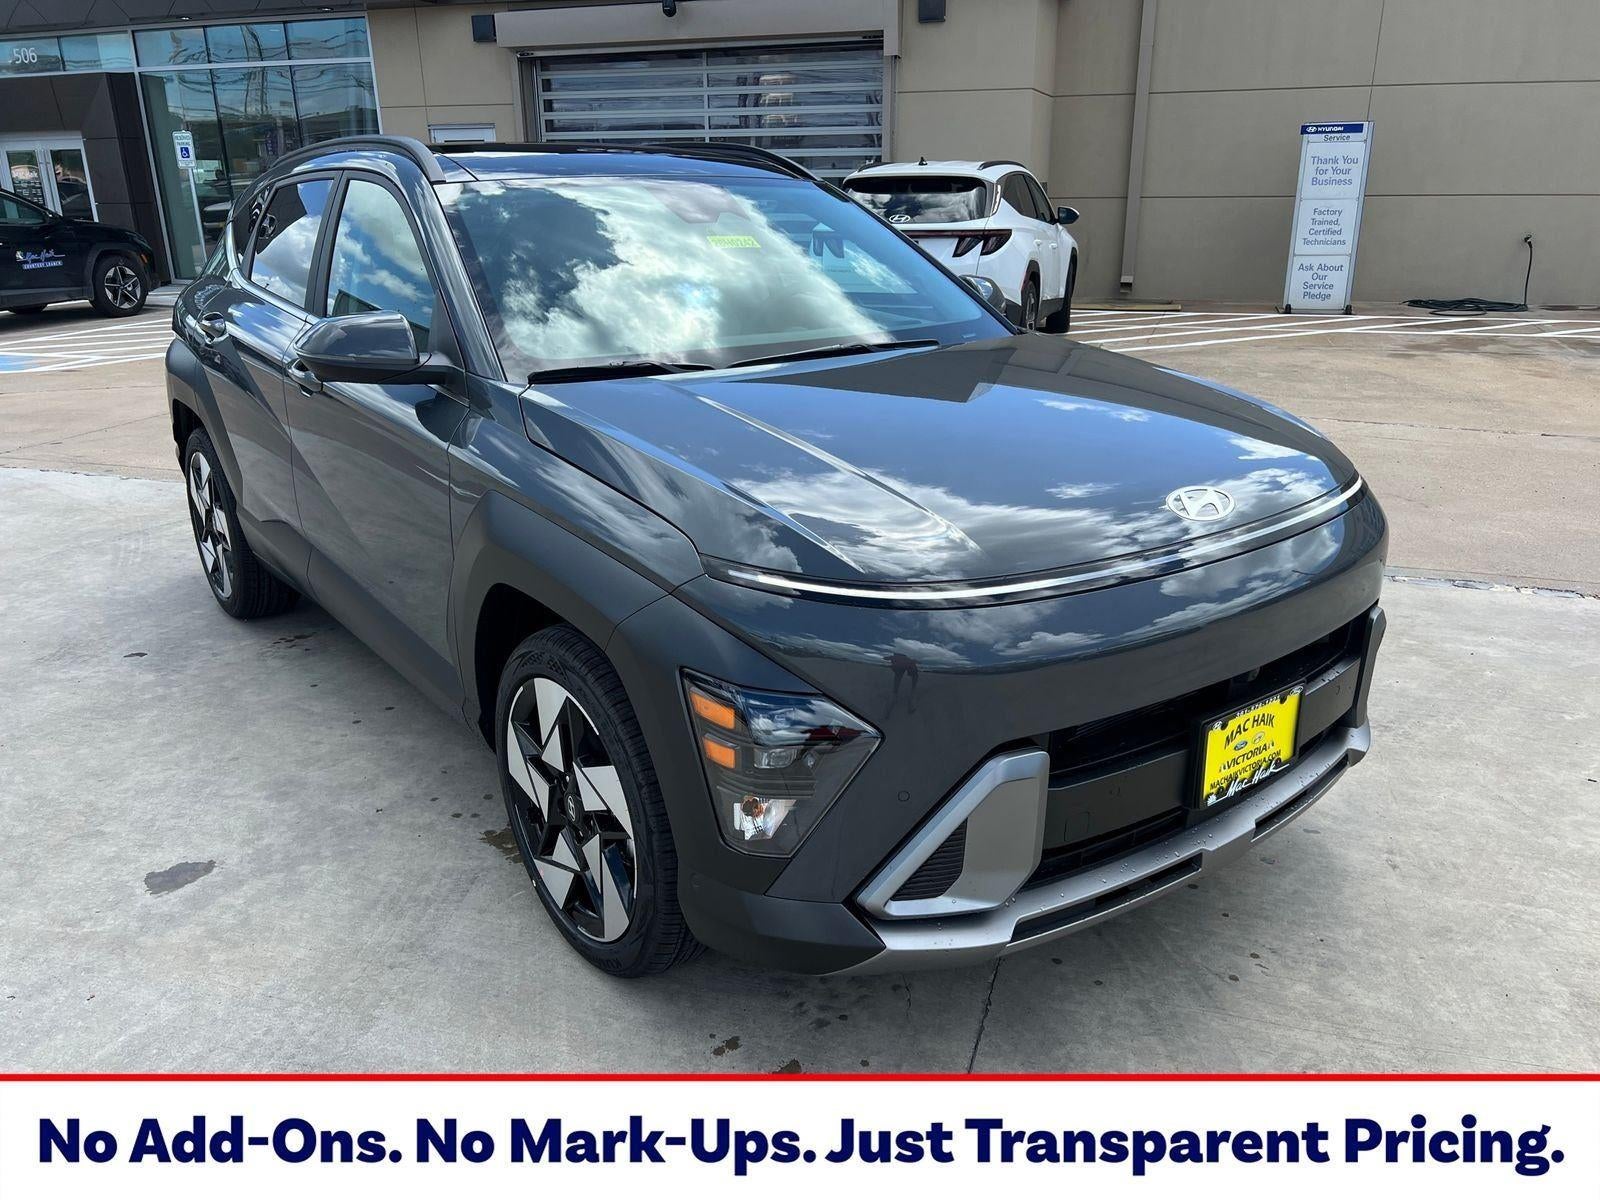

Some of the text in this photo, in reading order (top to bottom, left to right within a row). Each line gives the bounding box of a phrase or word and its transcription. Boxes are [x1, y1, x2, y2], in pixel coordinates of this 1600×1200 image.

[8, 47, 37, 64] 506
[1323, 134, 1351, 142] Service
[1311, 155, 1359, 165] Thank You
[1315, 166, 1352, 175] for Your
[1311, 176, 1353, 186] Business
[1313, 208, 1343, 217] Factory
[1310, 218, 1341, 226] Trained,
[1308, 228, 1343, 236] Certified
[1302, 237, 1346, 246] Technicians
[1297, 263, 1344, 272] Ask About
[1311, 272, 1328, 281] Our
[1302, 281, 1334, 290] Service
[1302, 291, 1332, 301] Pledge
[1224, 717, 1251, 750] MAC
[1251, 712, 1275, 729] HAIK
[1225, 745, 1268, 770] VICTORIA
